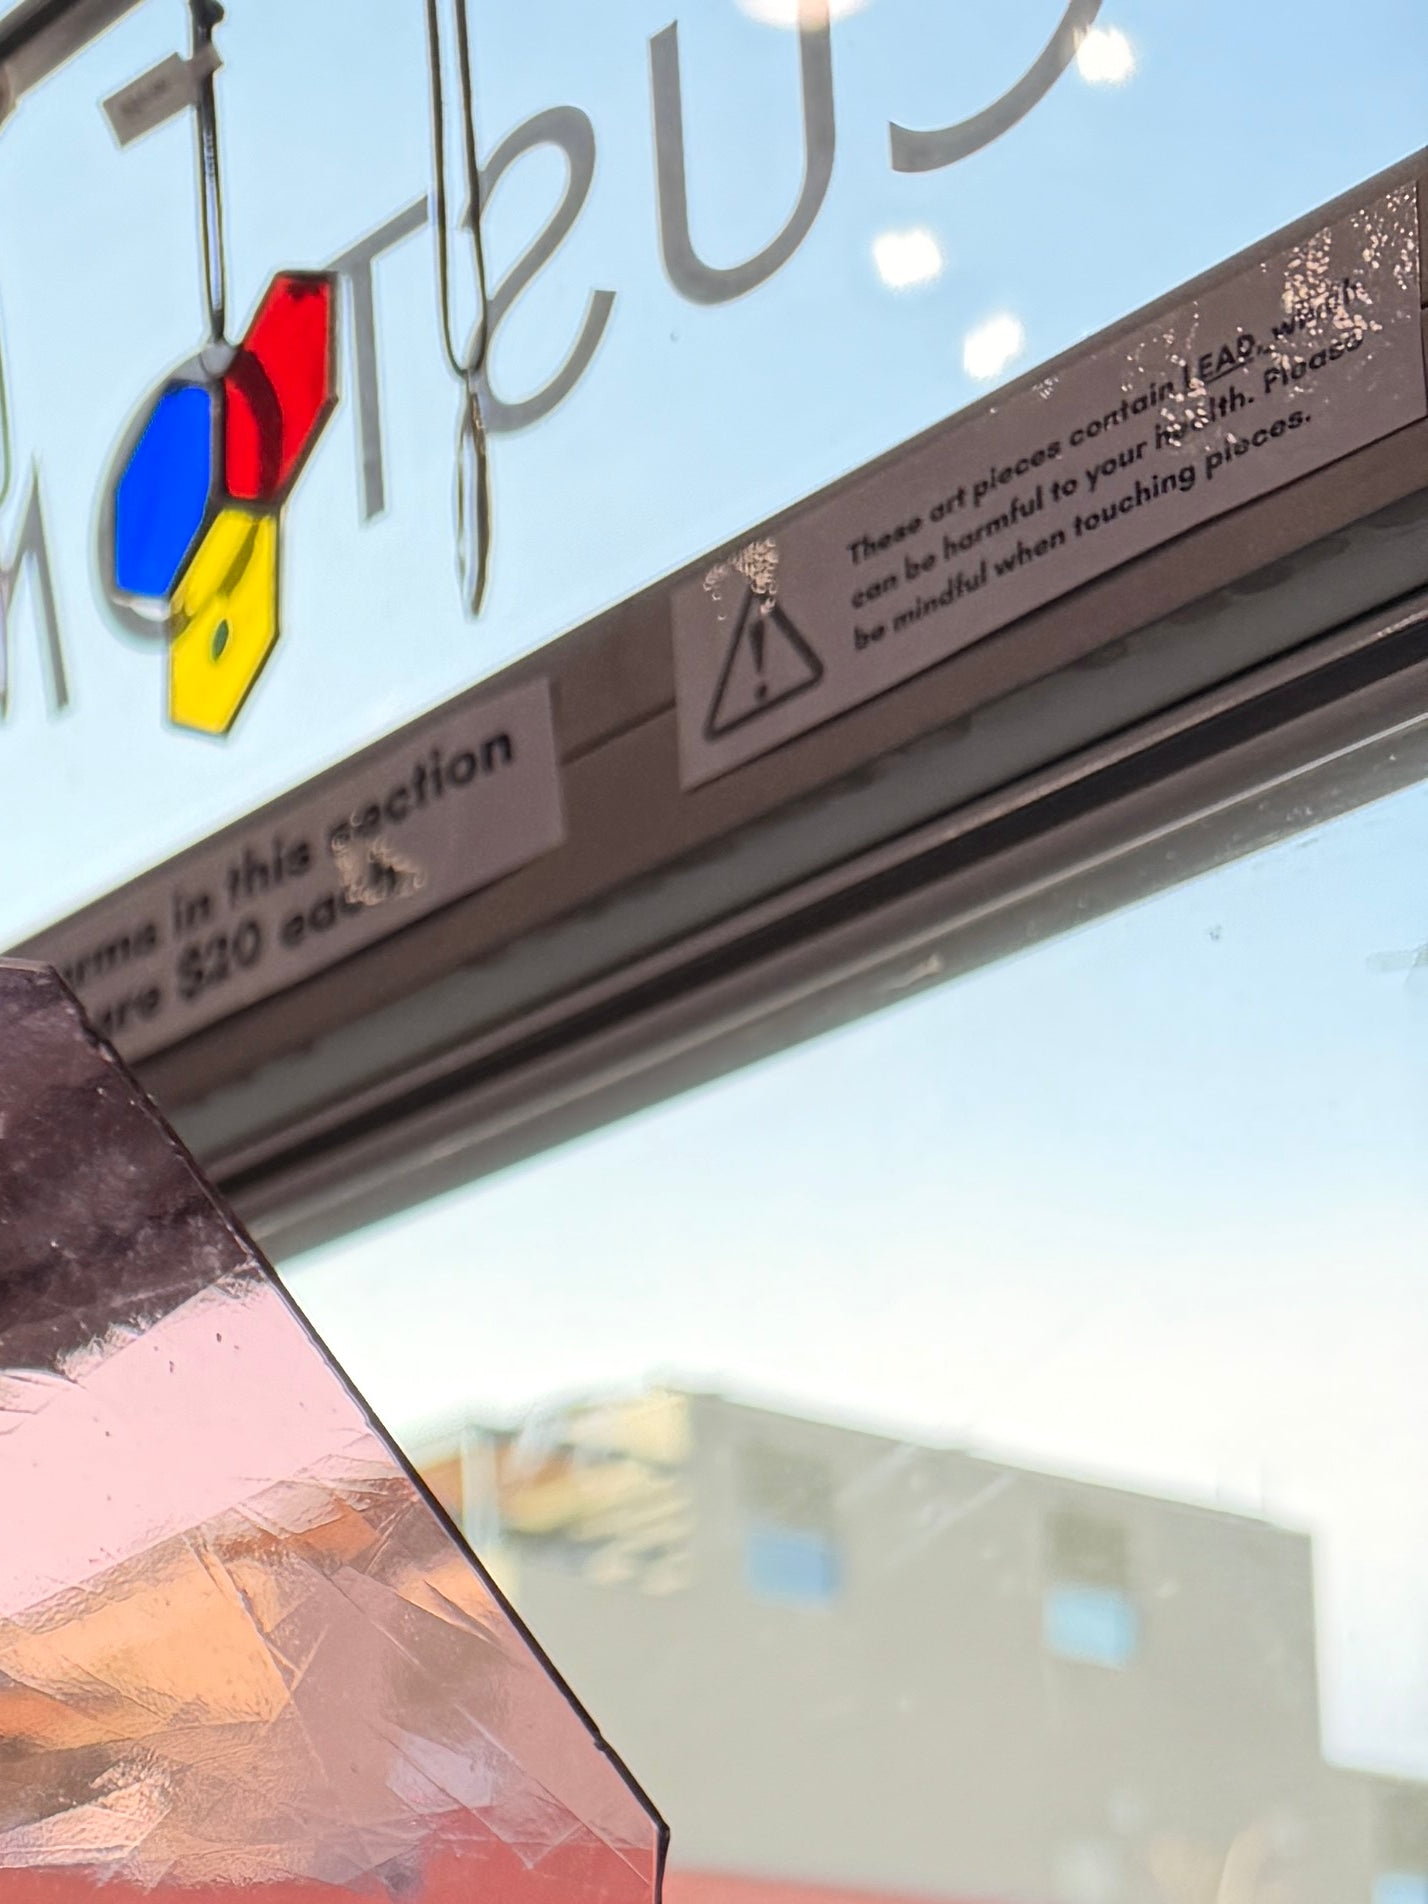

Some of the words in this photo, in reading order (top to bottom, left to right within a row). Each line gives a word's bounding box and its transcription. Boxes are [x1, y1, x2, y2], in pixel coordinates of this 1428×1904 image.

[848, 517, 923, 564] These
[929, 486, 966, 523] art
[973, 440, 1063, 508] pieces
[1068, 378, 1175, 448] contain
[850, 573, 898, 609] can
[904, 553, 937, 581] be
[942, 485, 1044, 560] harmful
[1050, 477, 1079, 503] to
[1085, 439, 1149, 494] your
[1155, 385, 1256, 451] health.
[1262, 335, 1366, 394] Please
[854, 623, 886, 651] be
[892, 559, 988, 632] mindful
[993, 528, 1067, 578] when
[1073, 463, 1196, 537] touching
[1204, 409, 1312, 481] pieces.
[171, 889, 211, 936] in
[227, 832, 312, 901] this
[330, 731, 513, 854] section
[176, 916, 262, 1000] $20
